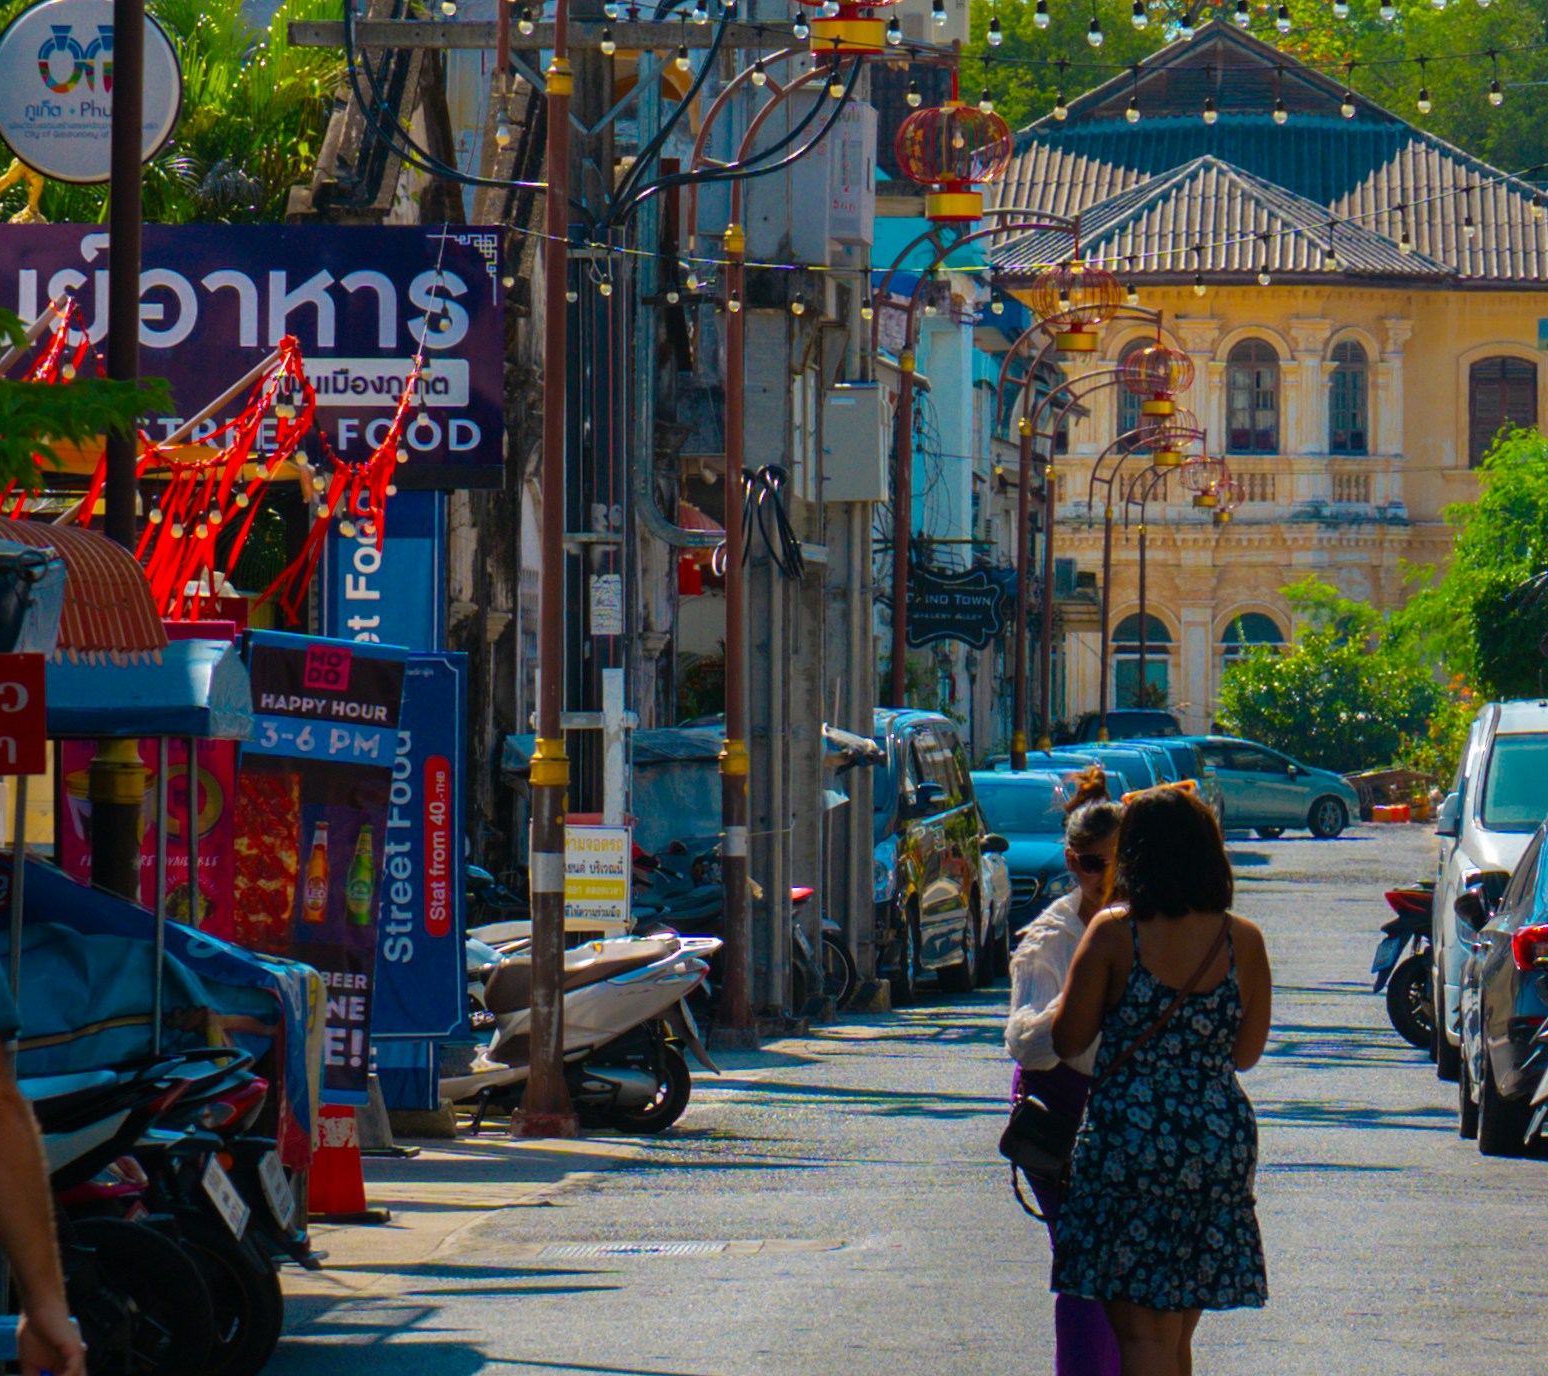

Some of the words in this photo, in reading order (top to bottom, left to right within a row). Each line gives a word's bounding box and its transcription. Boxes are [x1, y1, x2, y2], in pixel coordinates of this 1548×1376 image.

[337, 417, 482, 451] FOOD
[906, 592, 949, 604] CINO
[953, 593, 991, 606] TOWN
[260, 693, 327, 714] HAPPY
[331, 700, 388, 722] HOUR
[260, 721, 316, 752] 3-6
[328, 727, 381, 759] PM
[429, 831, 446, 878] from
[383, 839, 414, 964] Street
[429, 883, 446, 921] Stat
